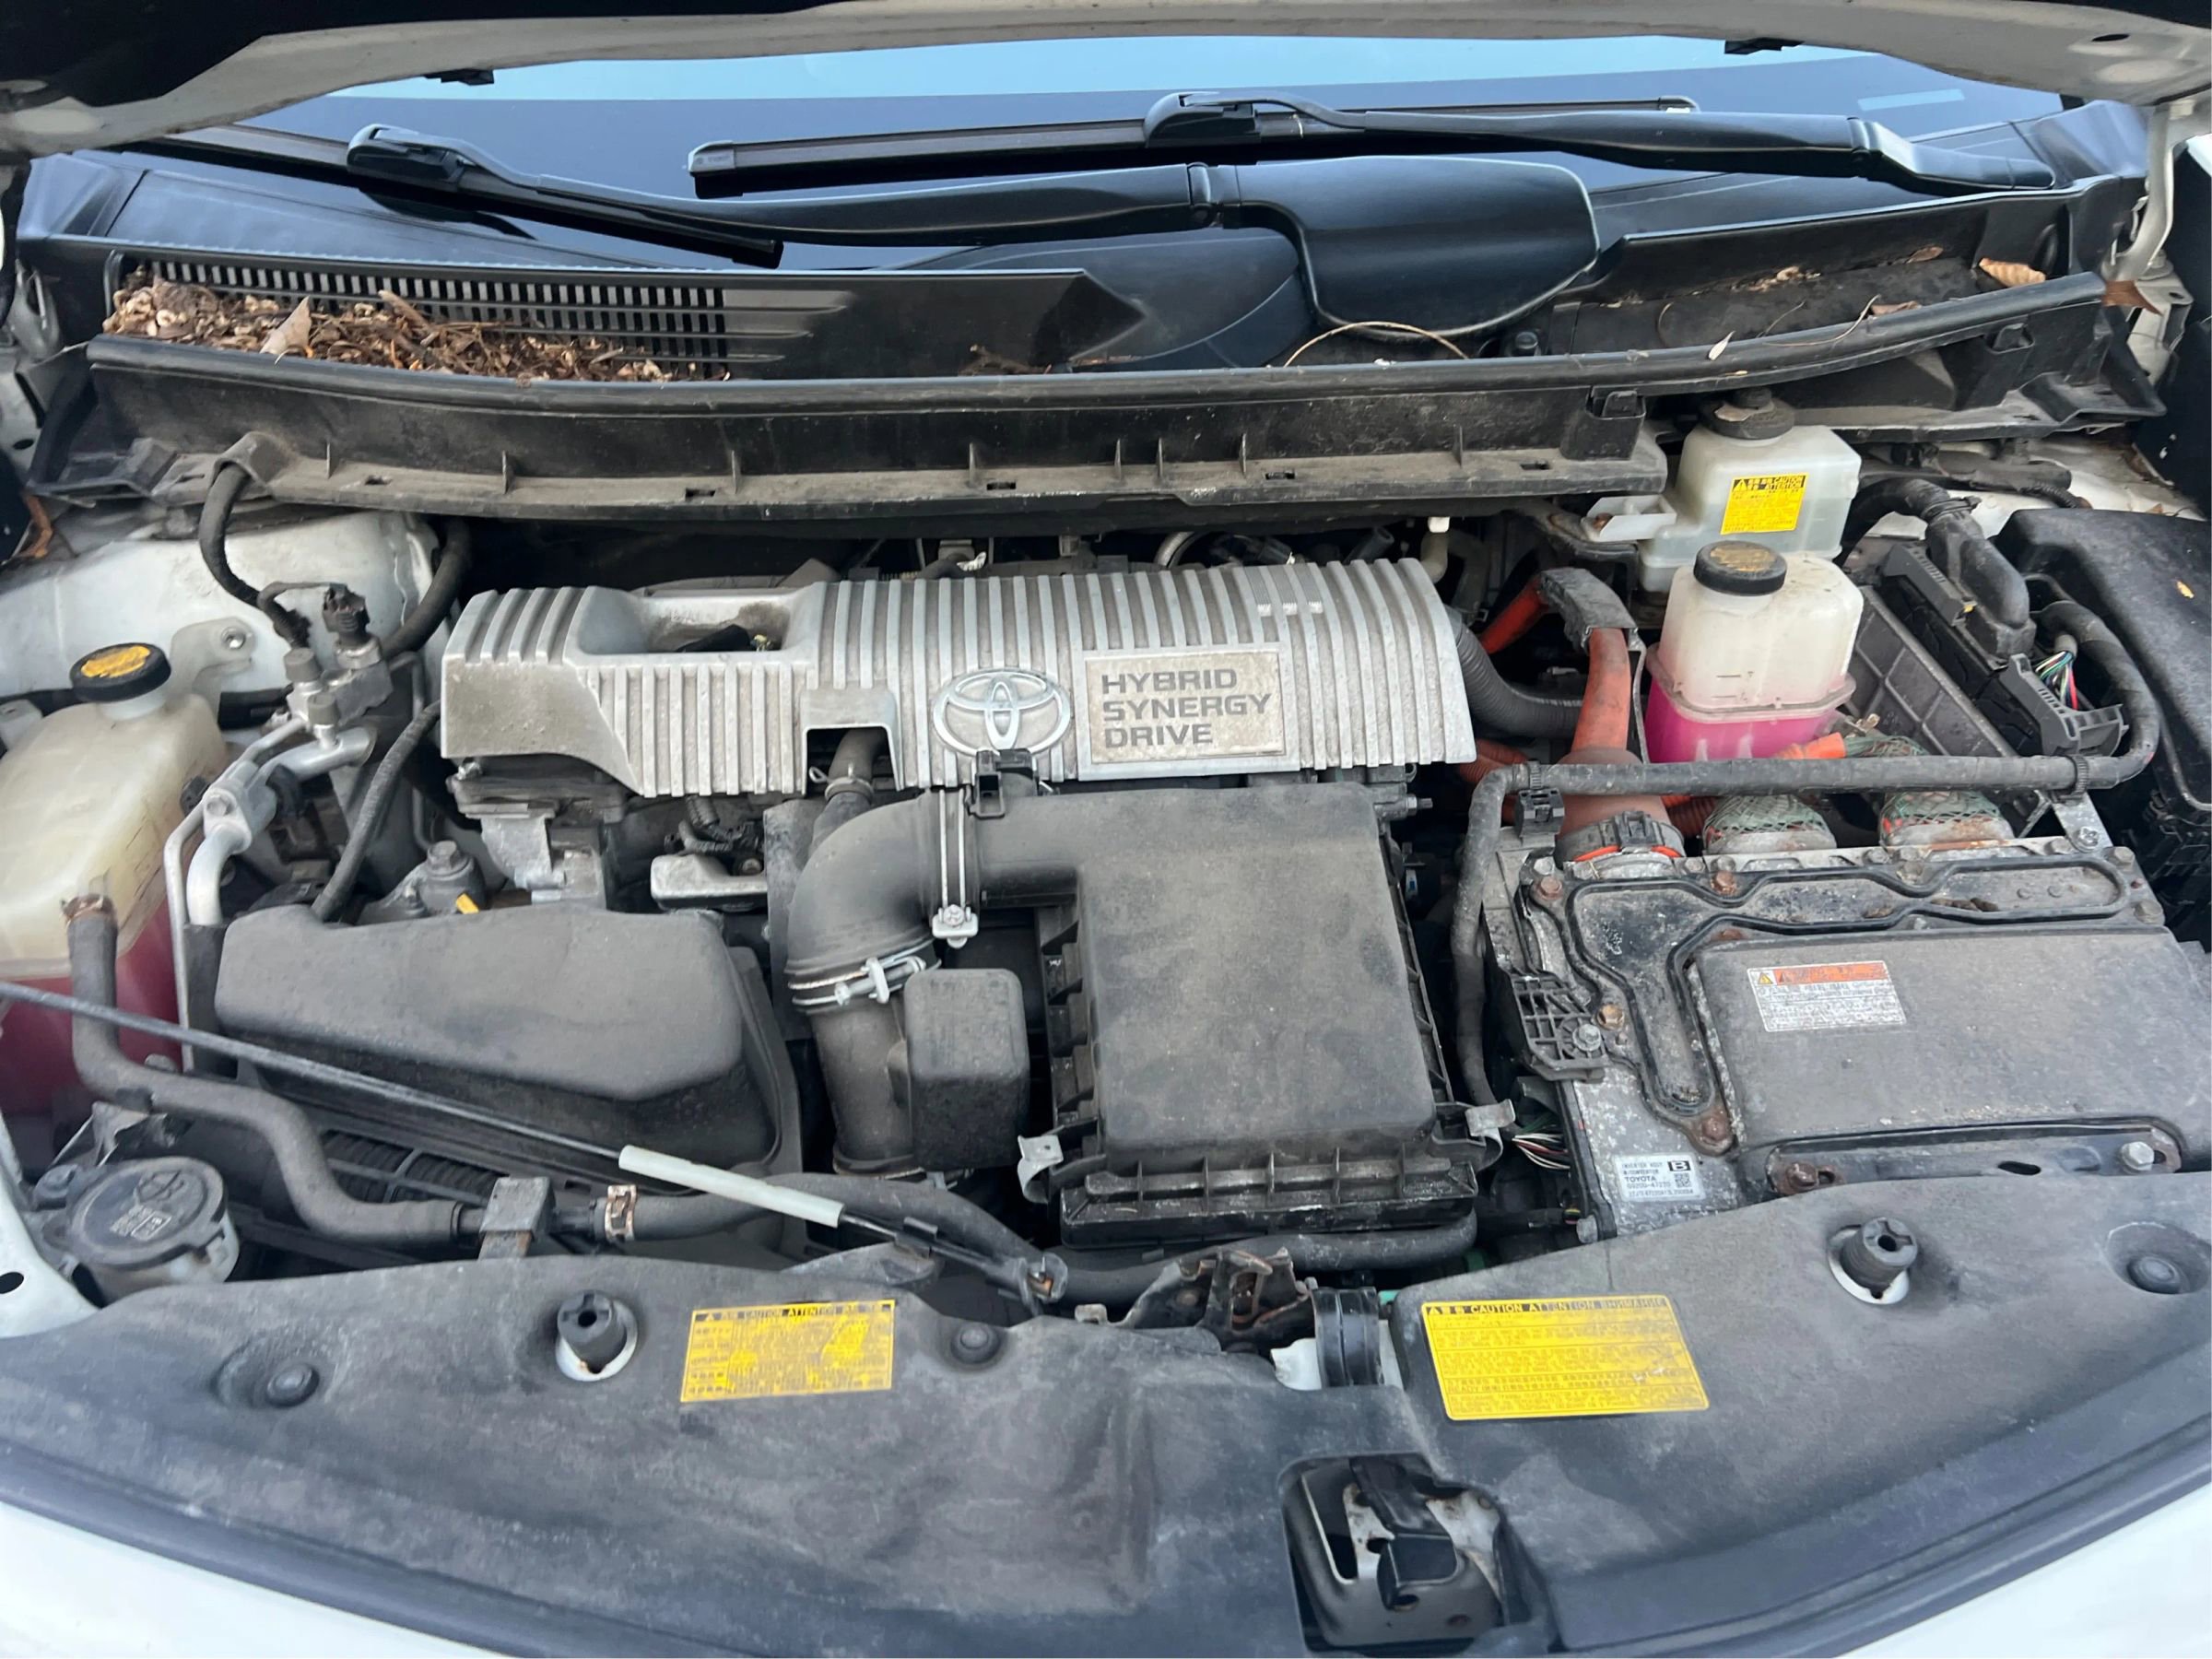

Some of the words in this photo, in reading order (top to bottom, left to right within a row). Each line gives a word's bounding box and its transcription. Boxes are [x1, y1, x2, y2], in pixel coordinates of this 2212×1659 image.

[1101, 668, 1237, 695] HYBRID
[1103, 693, 1272, 722] SYNERGY
[1105, 723, 1213, 748] DRIVE
[1670, 1160, 1688, 1171] B
[1470, 1303, 1524, 1314] CAUTION
[1528, 1300, 1595, 1312] ATTENTION
